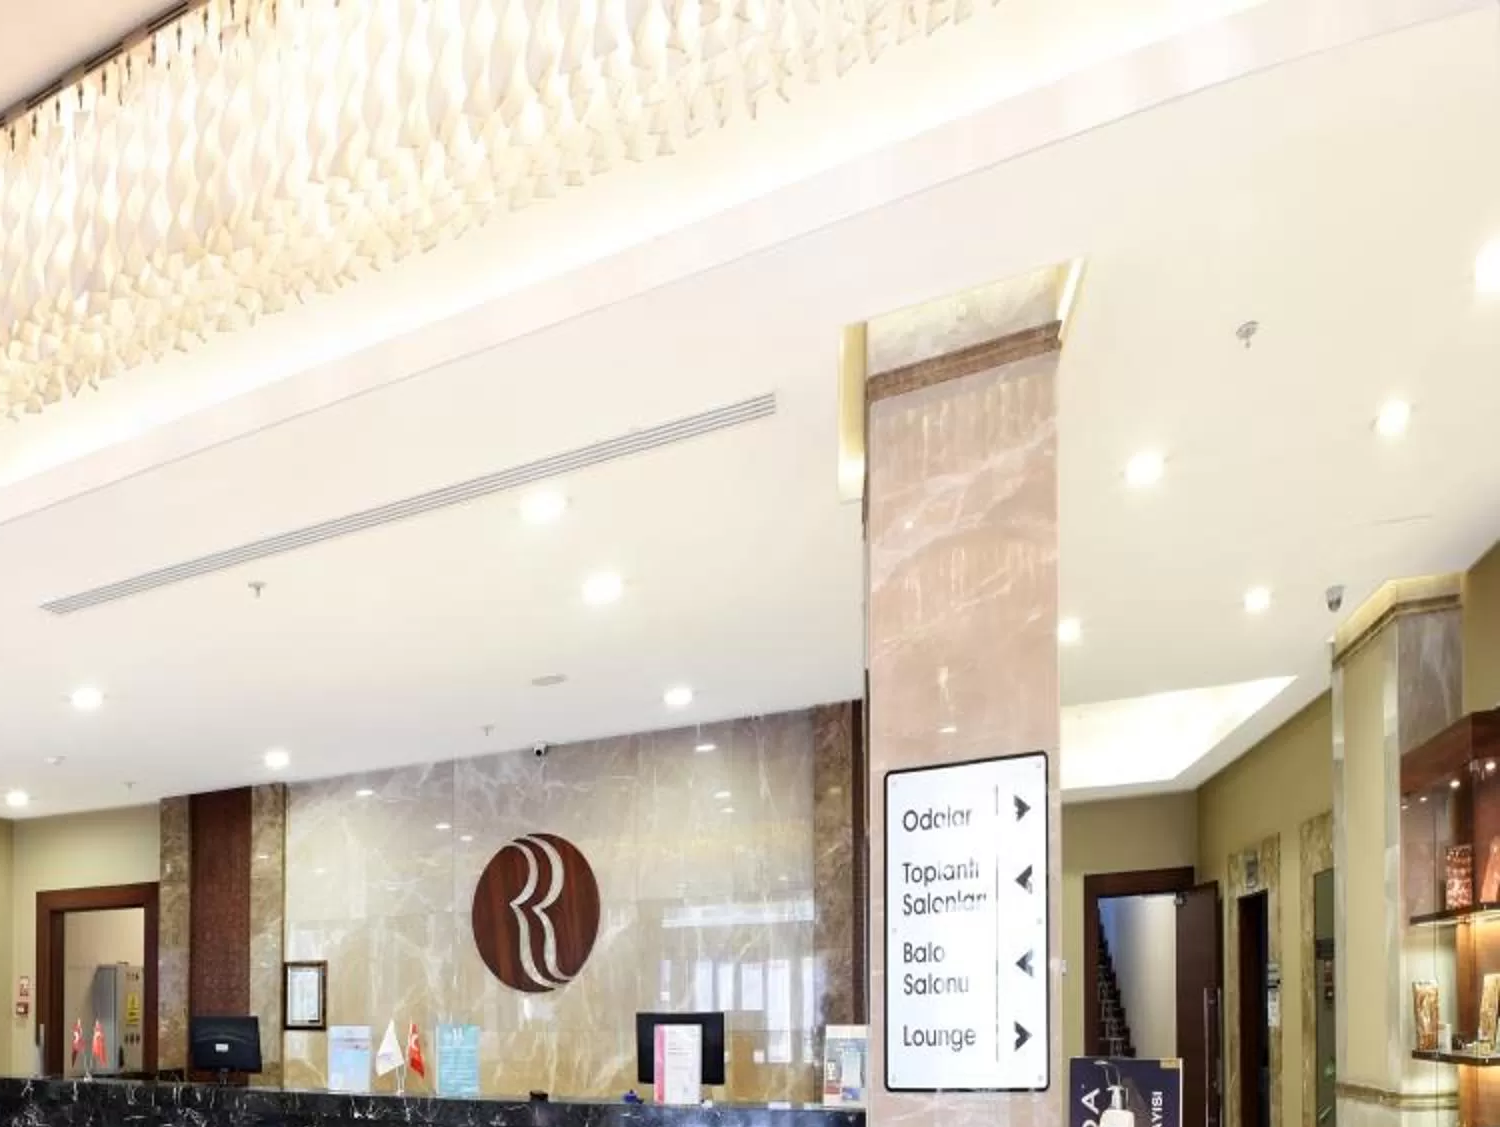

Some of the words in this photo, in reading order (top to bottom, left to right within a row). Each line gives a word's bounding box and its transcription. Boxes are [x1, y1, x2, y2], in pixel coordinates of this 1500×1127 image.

[902, 804, 972, 832] Odalar
[903, 941, 946, 964] Balo
[903, 972, 969, 996] Salonu
[903, 1024, 976, 1053] Lounge
